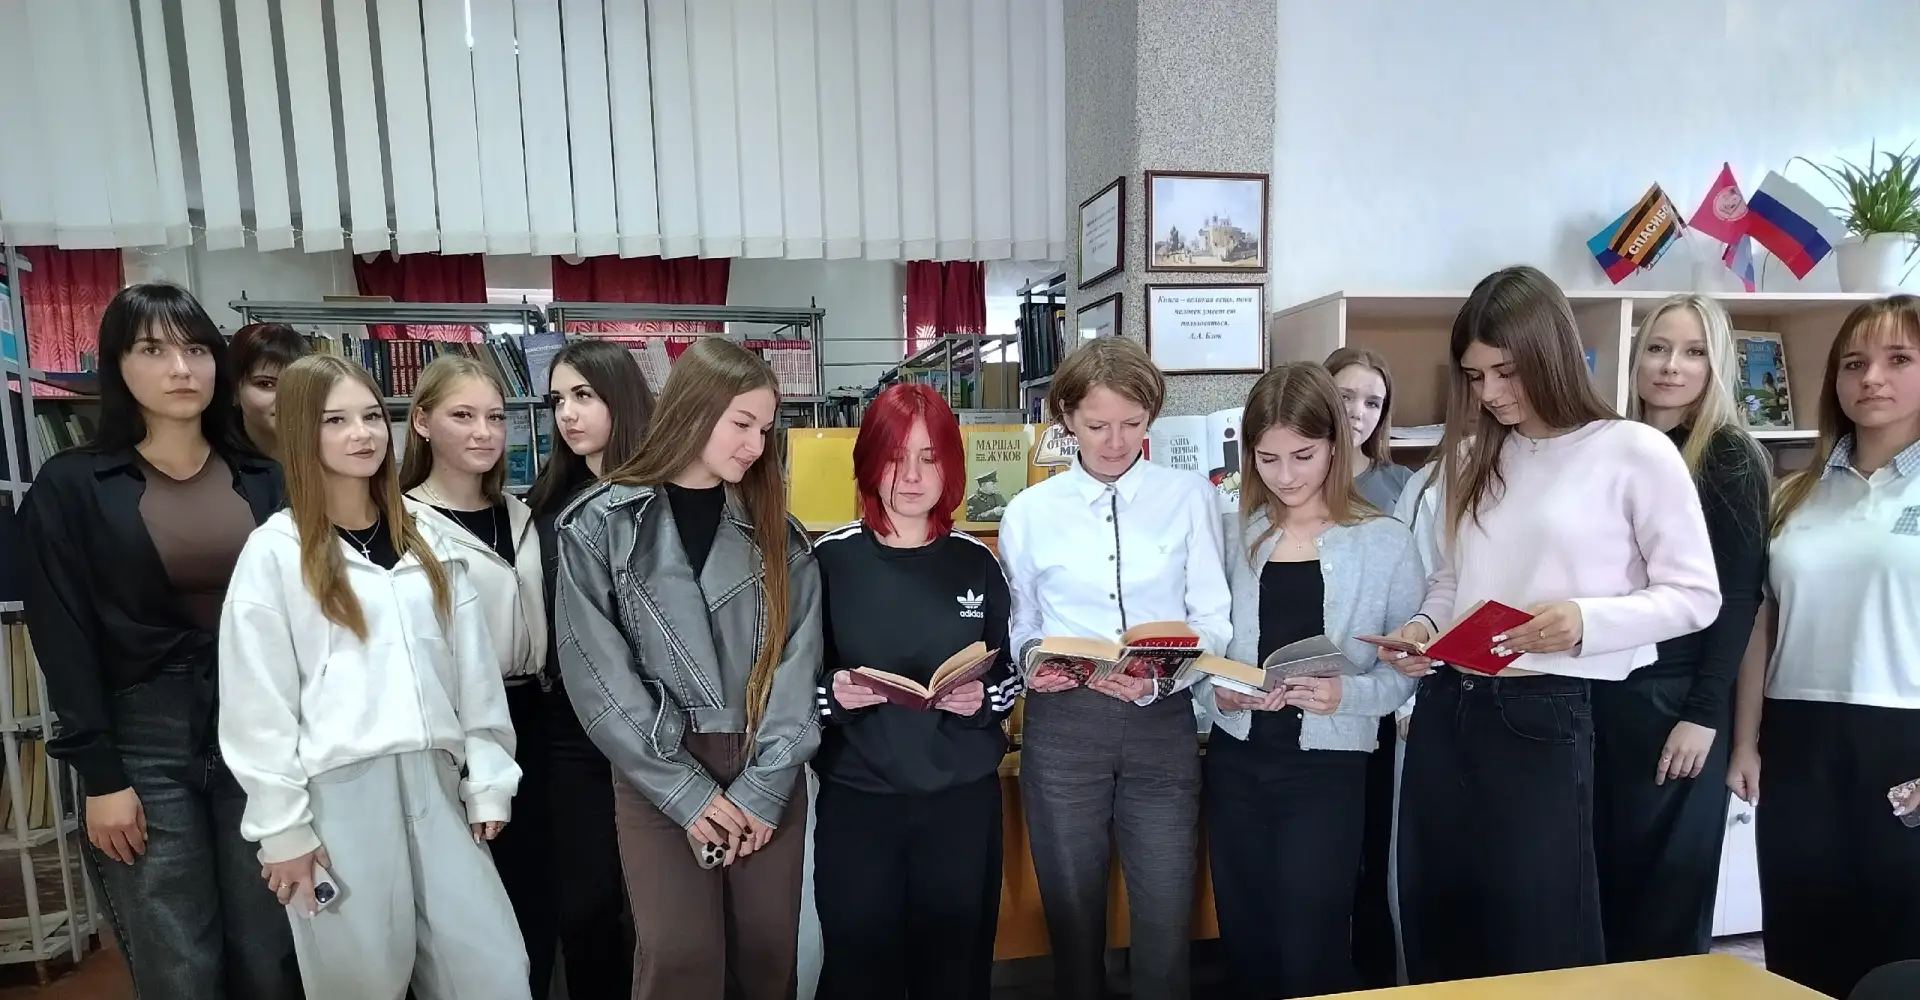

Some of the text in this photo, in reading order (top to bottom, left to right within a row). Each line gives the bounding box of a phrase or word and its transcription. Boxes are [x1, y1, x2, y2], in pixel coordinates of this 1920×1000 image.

[1157, 295, 1179, 304] Книга
[976, 439, 1020, 451] МАРШАЛ
[987, 450, 1021, 462] ЖУКОВ
[959, 609, 984, 619] adidas
